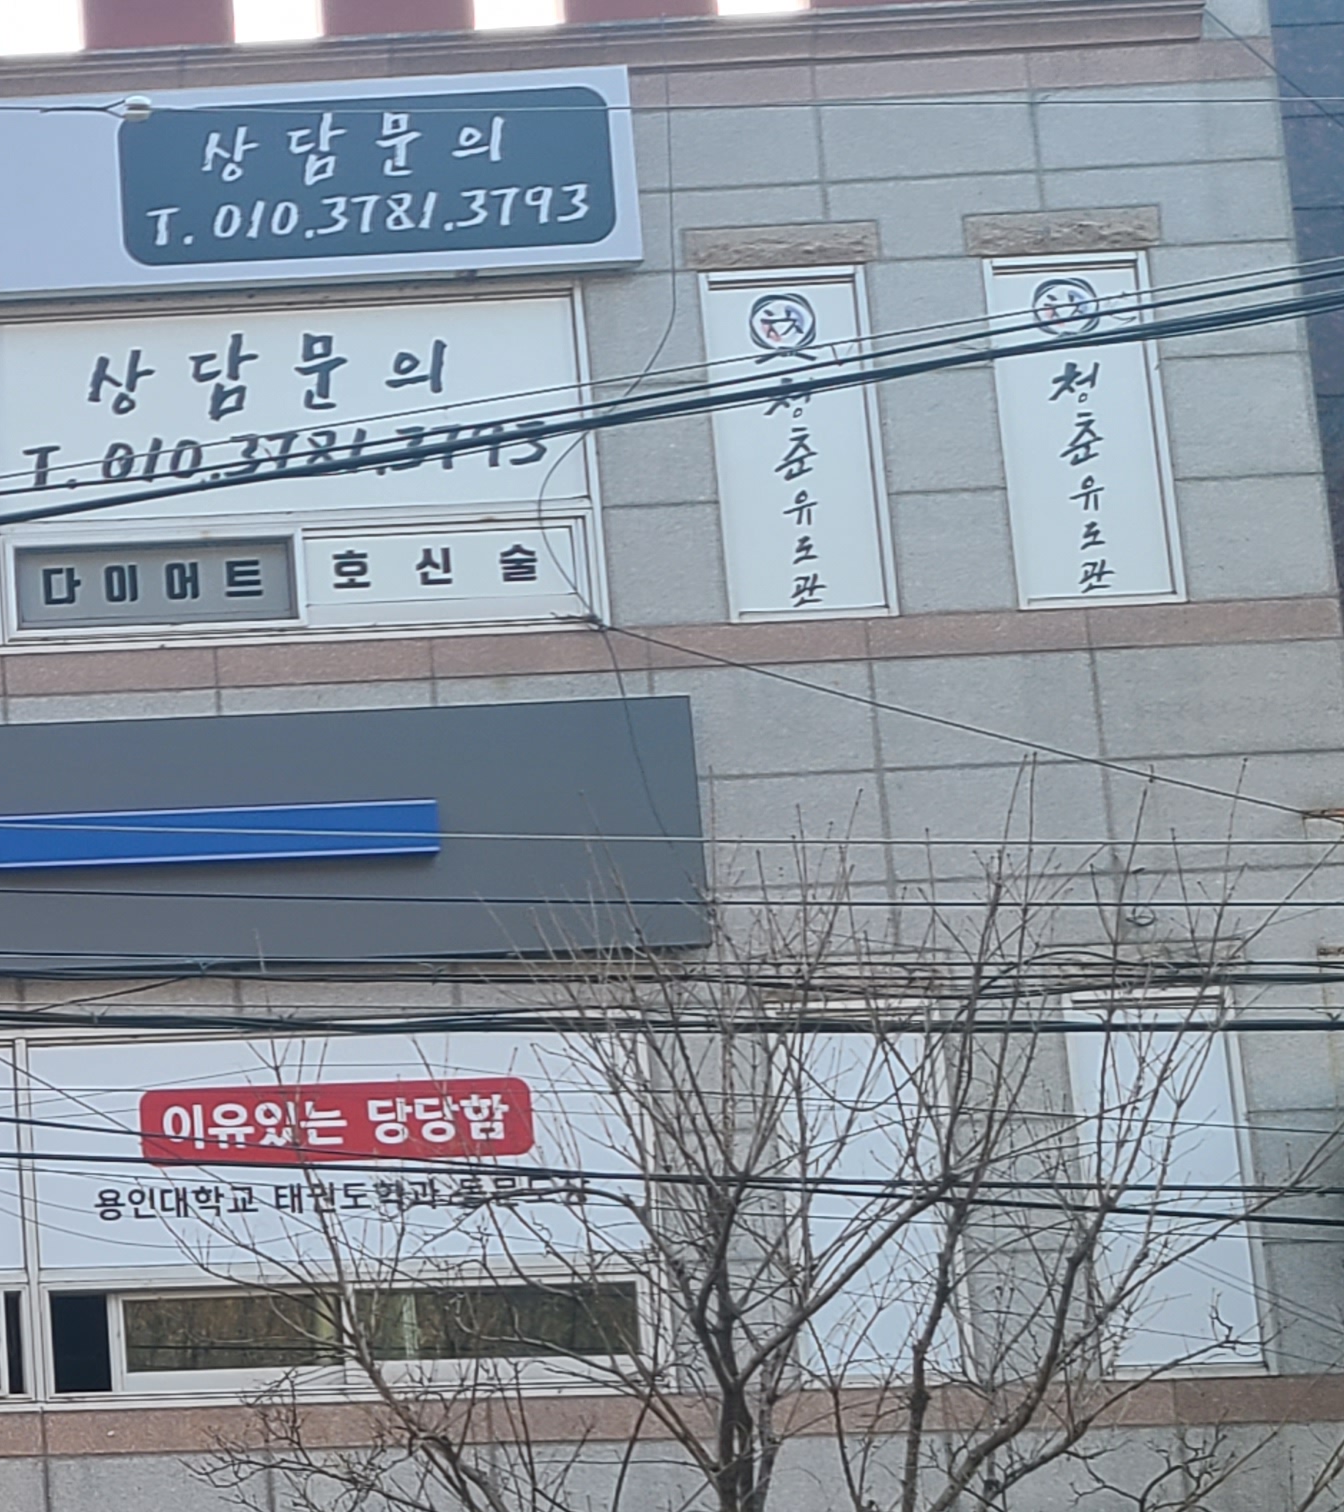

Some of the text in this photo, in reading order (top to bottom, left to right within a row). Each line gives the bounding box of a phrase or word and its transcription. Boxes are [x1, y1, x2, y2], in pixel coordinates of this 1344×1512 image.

[147, 183, 590, 245] T. 010.3781.3793
[42, 561, 263, 606] 다이어트
[332, 545, 539, 588] 호신술
[162, 1090, 509, 1149] 이유있는 당당함
[97, 1185, 259, 1220] 용인대학교
